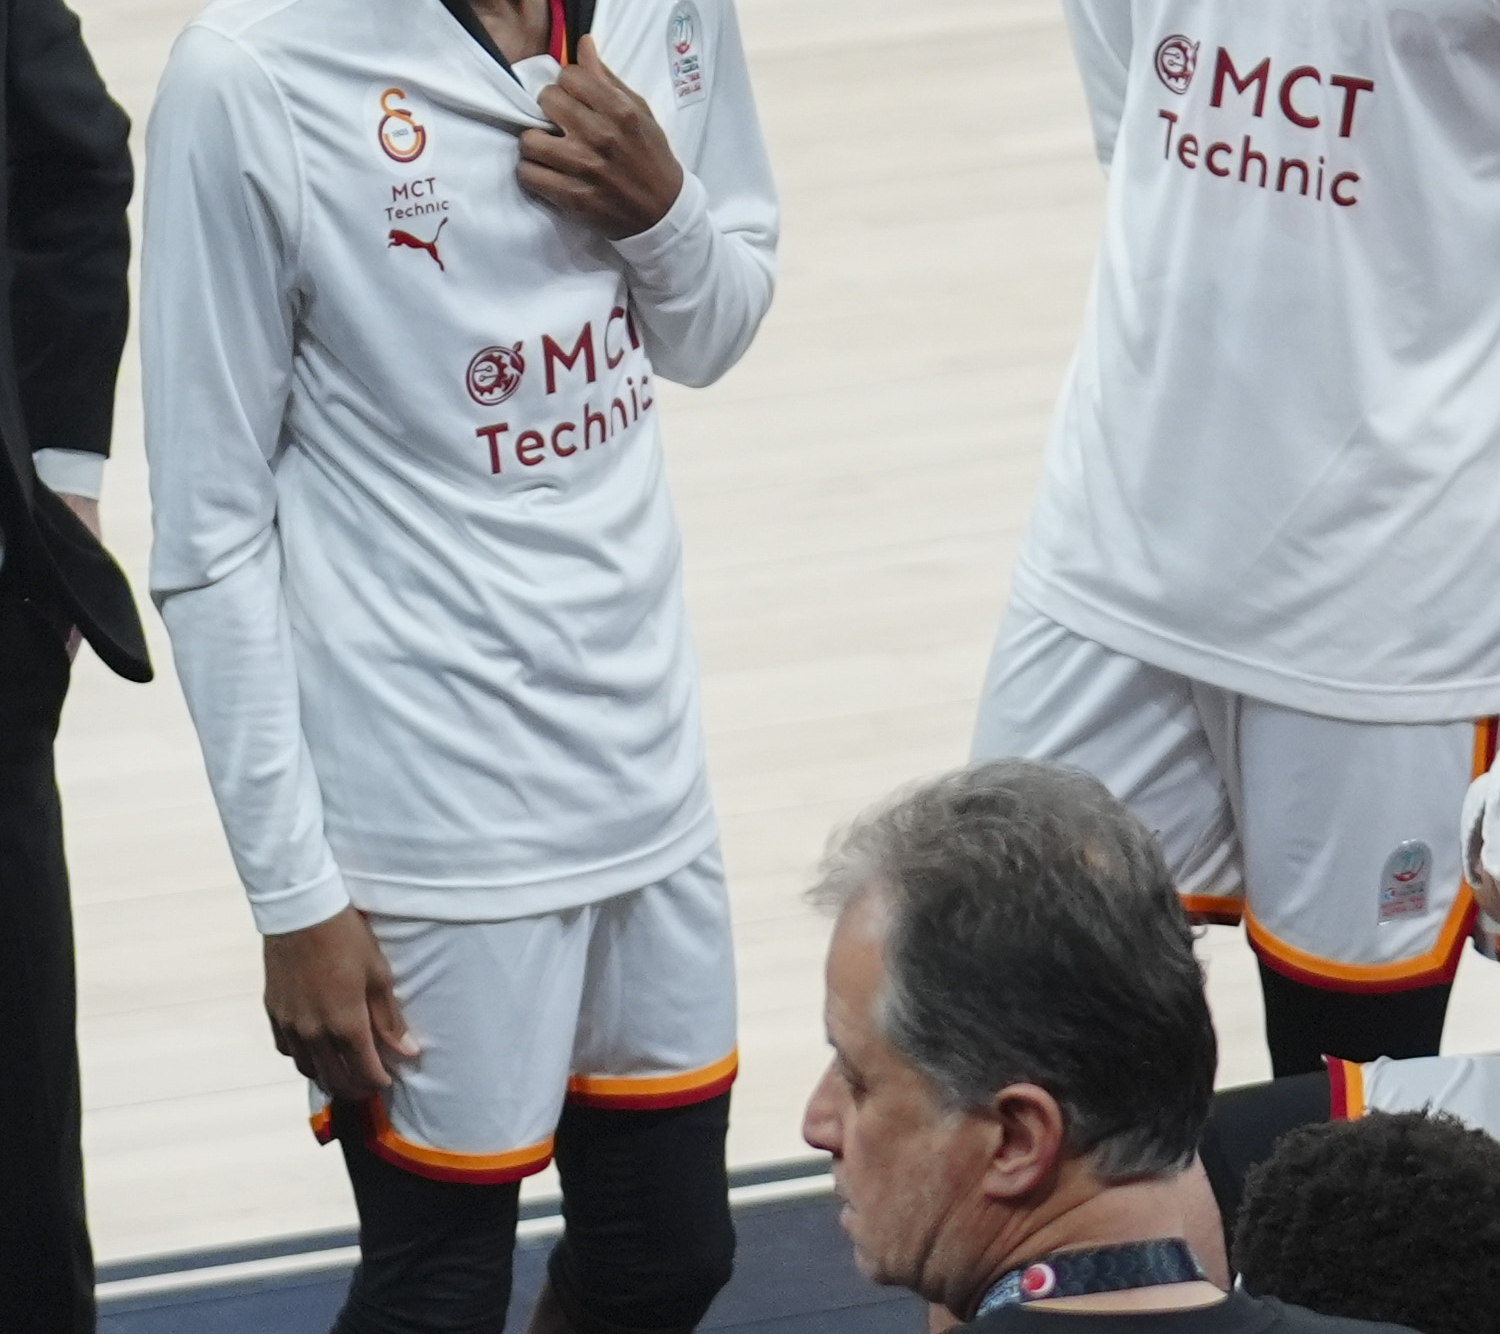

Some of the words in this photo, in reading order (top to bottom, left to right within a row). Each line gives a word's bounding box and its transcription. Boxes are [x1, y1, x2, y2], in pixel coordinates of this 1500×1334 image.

[1210, 46, 1375, 138] MCT
[392, 177, 436, 202] MCT
[1158, 109, 1361, 207] Technic
[384, 200, 450, 221] Technic
[476, 375, 654, 474] Technic
